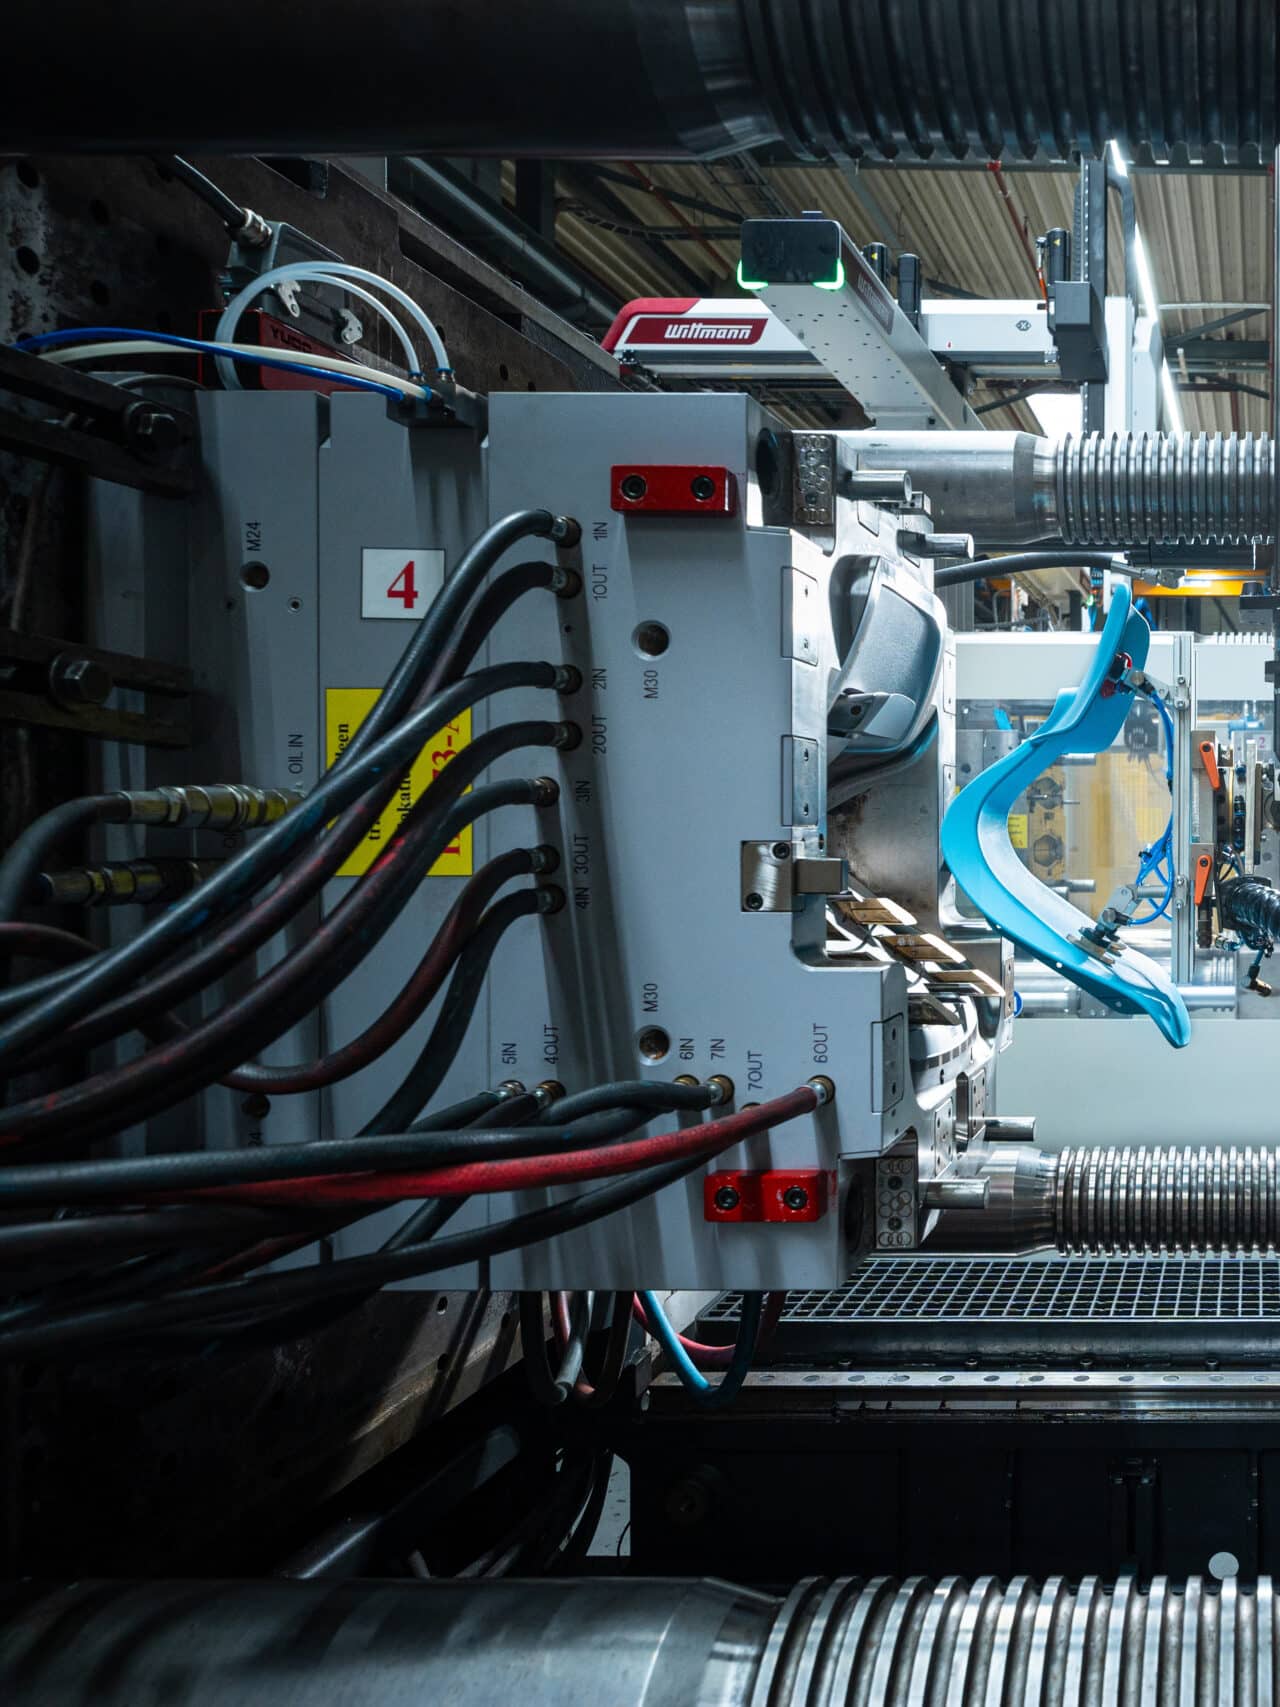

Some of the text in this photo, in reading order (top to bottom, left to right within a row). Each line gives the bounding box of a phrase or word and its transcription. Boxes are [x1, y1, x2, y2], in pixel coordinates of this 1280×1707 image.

[246, 522, 261, 551] M24
[592, 522, 608, 541] 1IN
[387, 560, 418, 609] 4
[592, 564, 608, 602] 1OUT
[592, 668, 607, 690] 2IN
[644, 670, 658, 699] M30
[592, 714, 607, 755] 2OUT
[287, 734, 304, 774] OIL IN
[576, 780, 590, 802] 3IN
[574, 834, 589, 875] 3OUT
[575, 887, 589, 910] 4IN
[643, 983, 658, 1012] M30
[502, 1042, 517, 1065] 5IN
[543, 1024, 559, 1065] 4OUT
[679, 1037, 694, 1060] 6IN
[711, 1038, 725, 1061] 7IN
[813, 1023, 828, 1064] 6OUT
[747, 1050, 763, 1091] 7OUT
